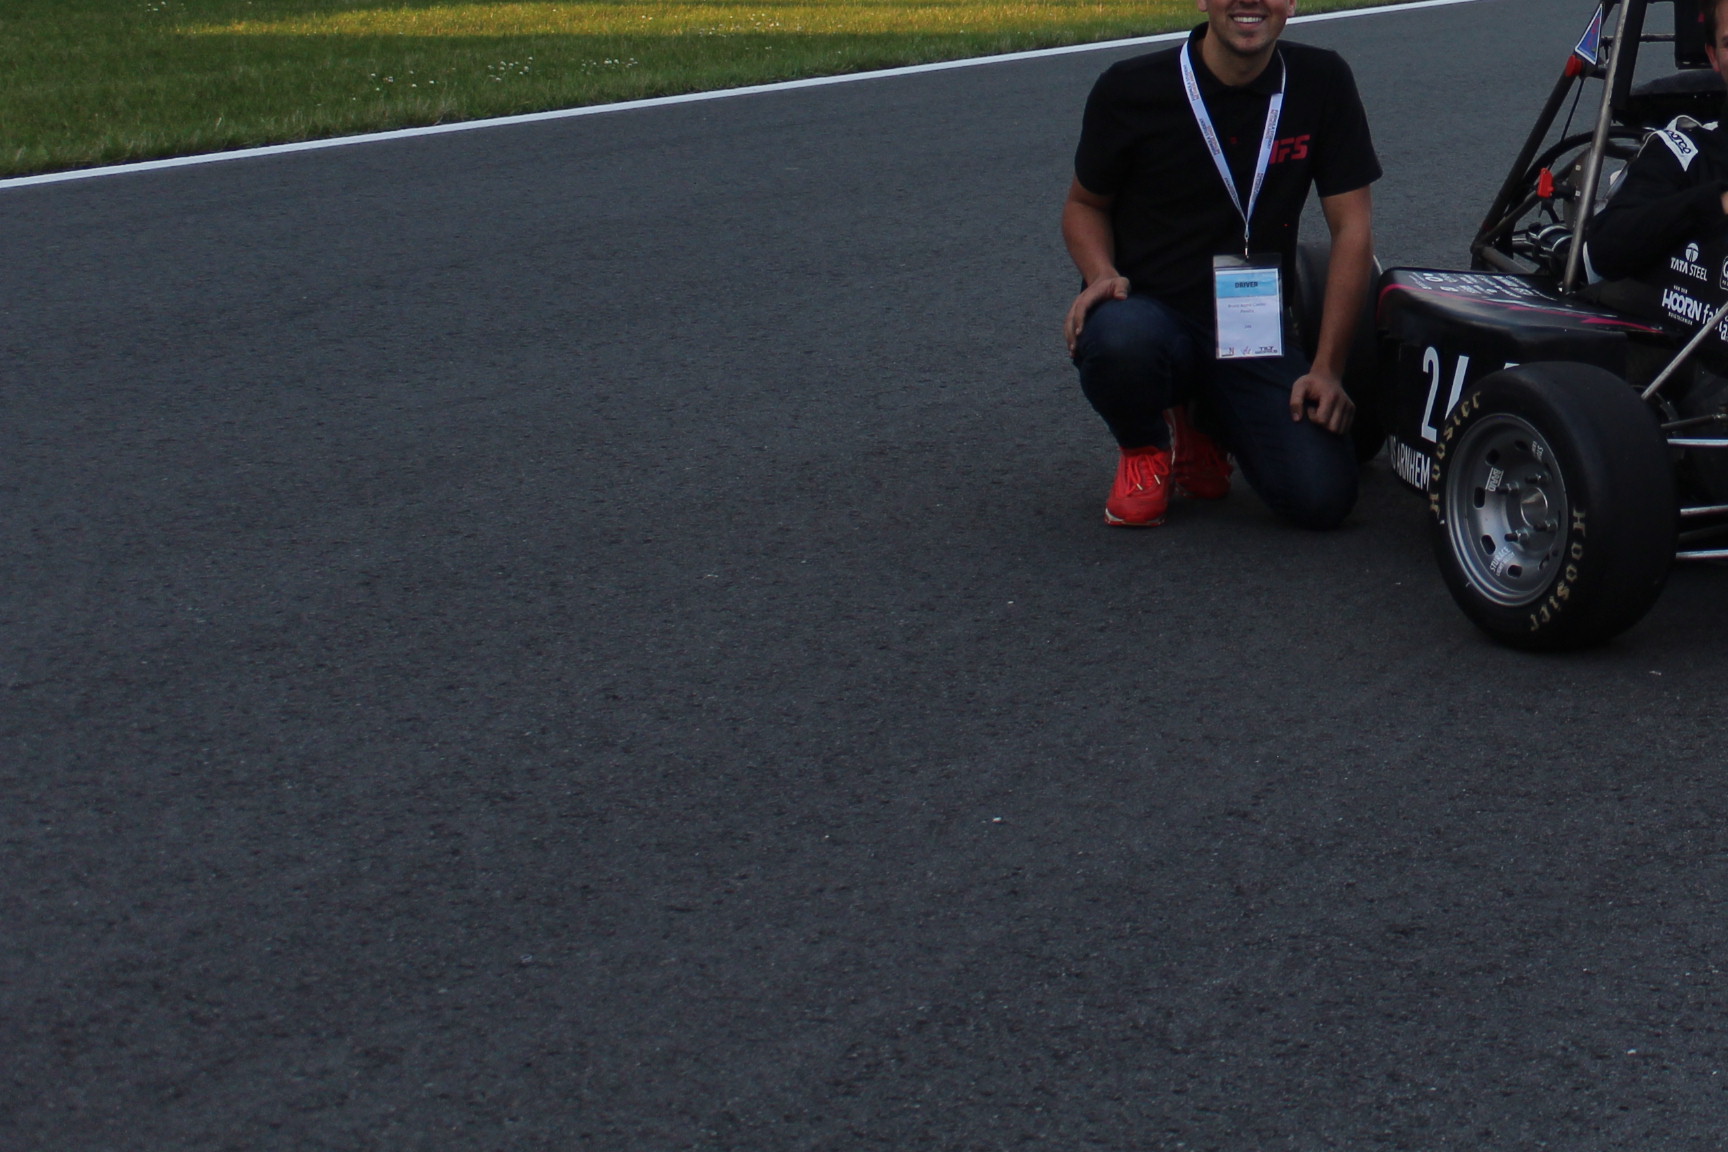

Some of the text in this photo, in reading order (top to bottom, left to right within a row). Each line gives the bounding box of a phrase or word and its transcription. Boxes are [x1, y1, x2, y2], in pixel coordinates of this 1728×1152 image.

[1670, 257, 1708, 281] TATA STEEL
[1661, 288, 1702, 321] HOORN
